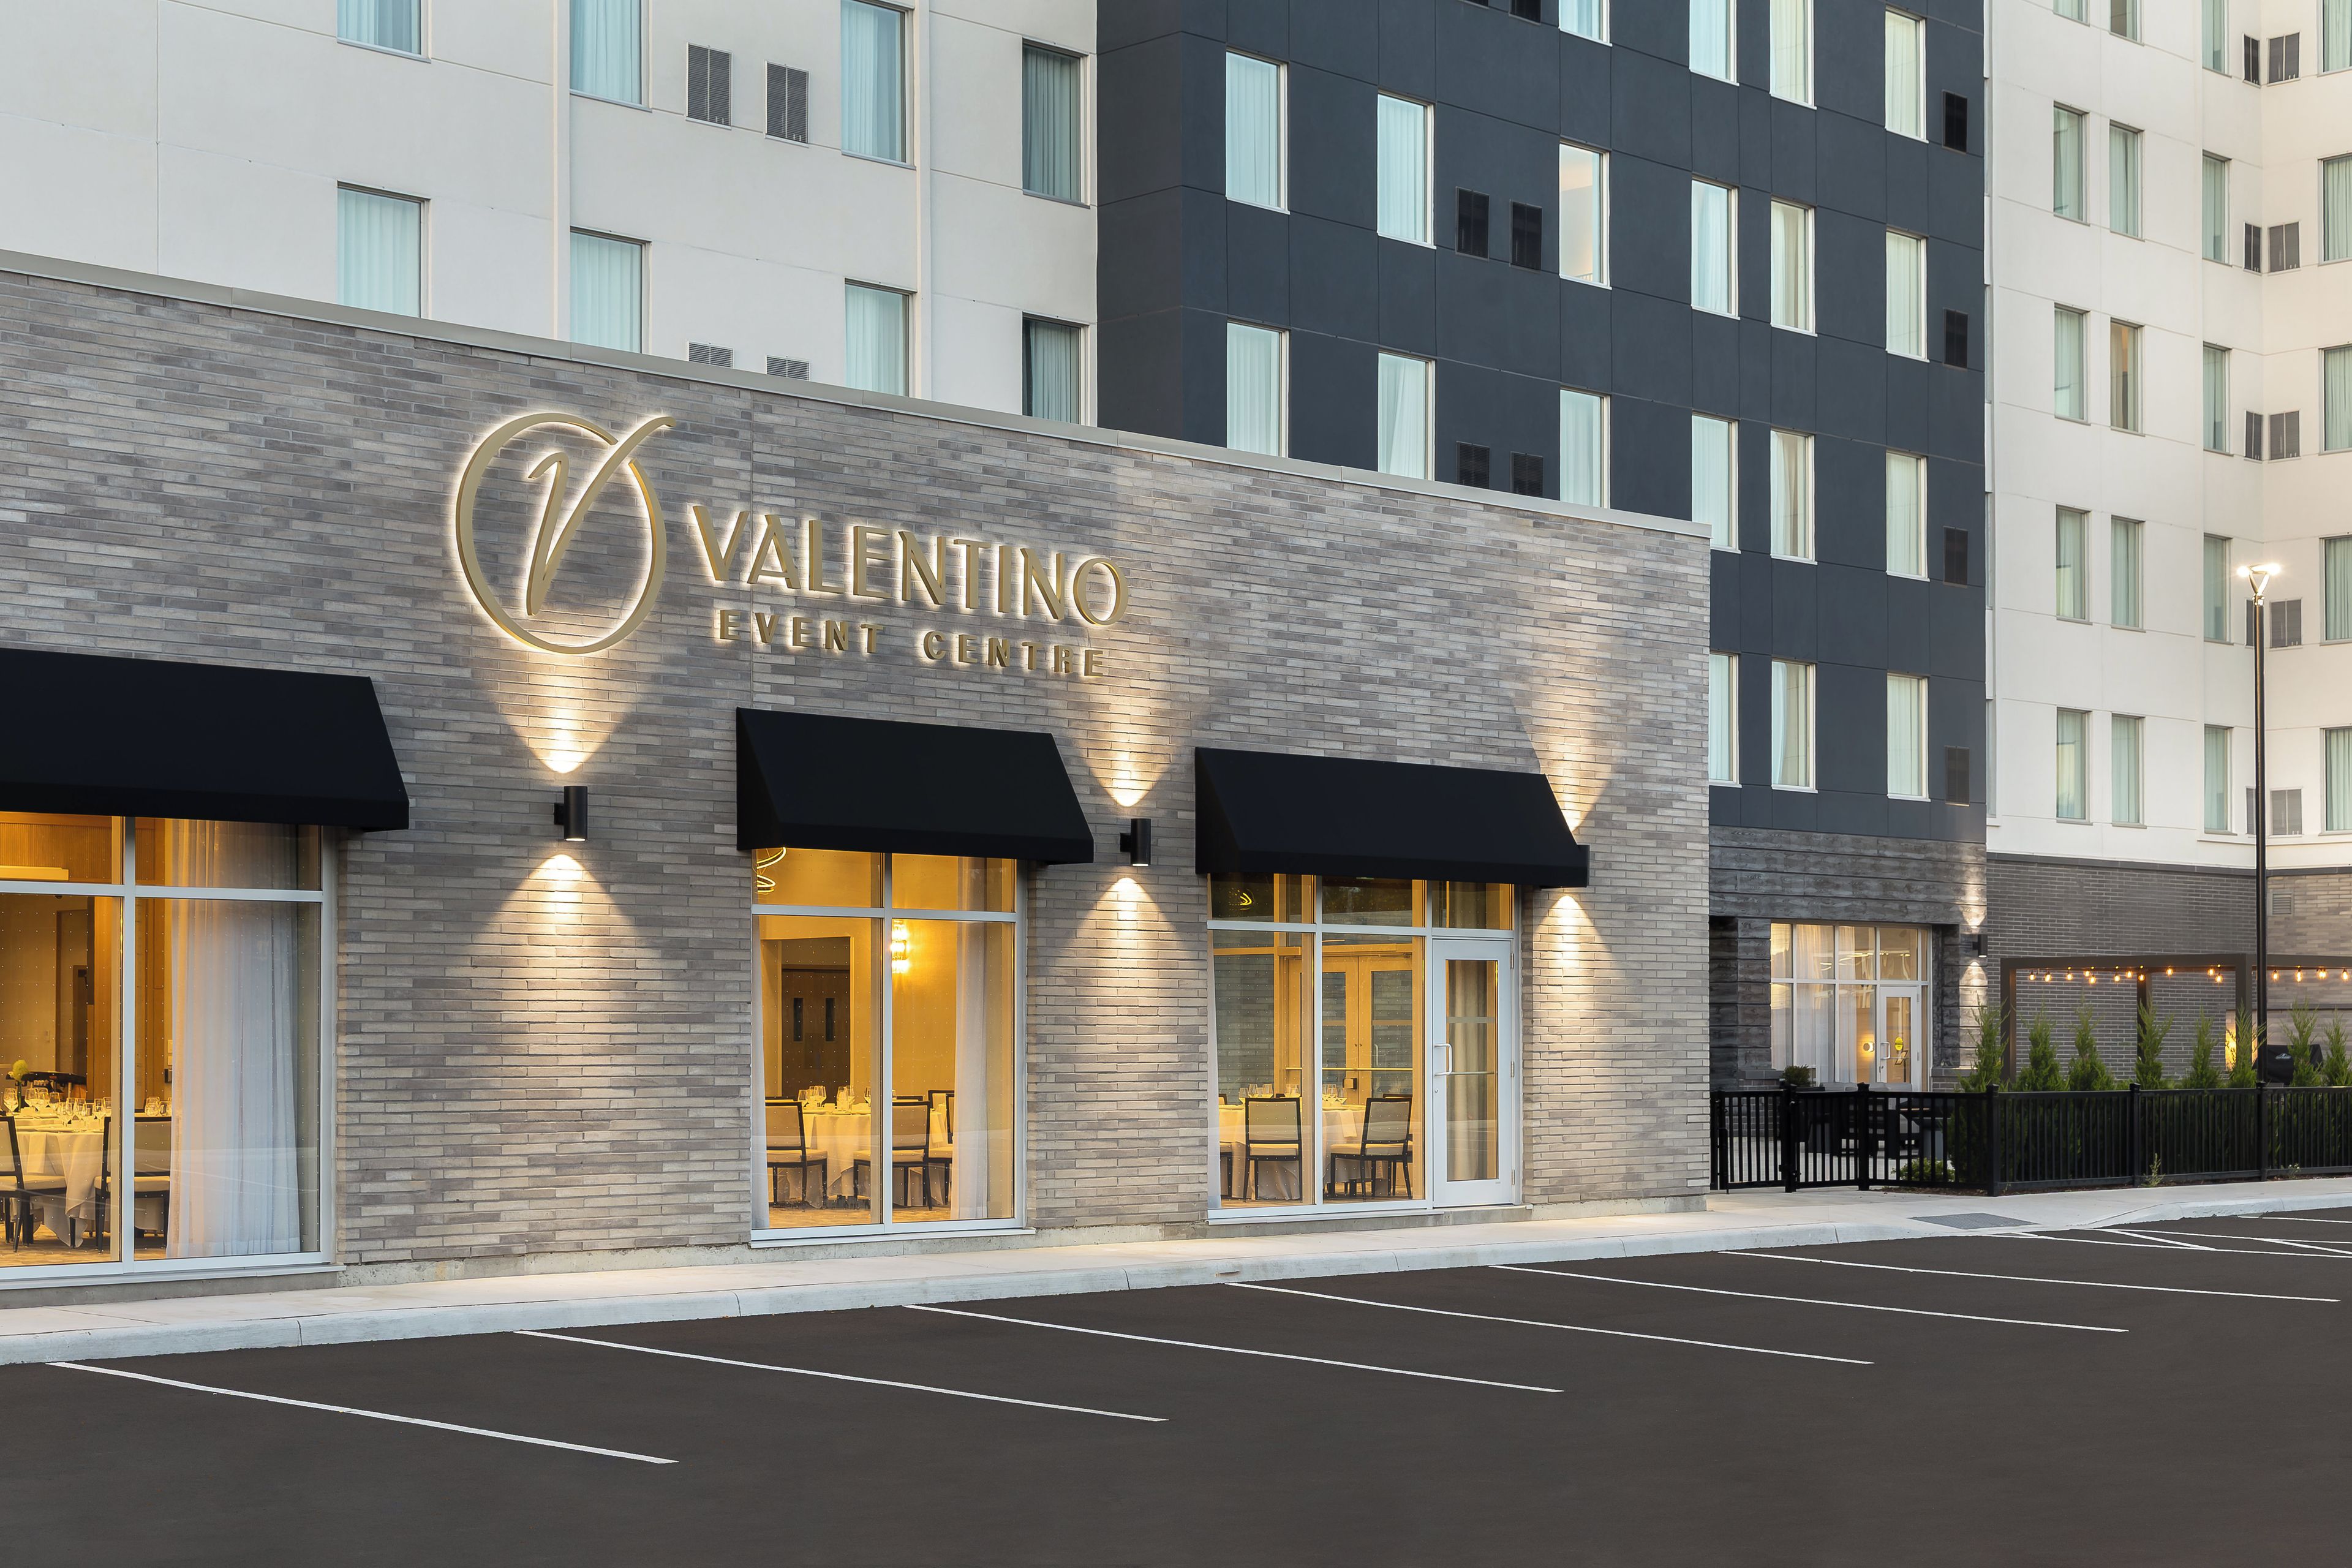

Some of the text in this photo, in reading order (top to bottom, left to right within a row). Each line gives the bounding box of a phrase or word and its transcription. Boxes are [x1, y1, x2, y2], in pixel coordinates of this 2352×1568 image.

[692, 505, 1129, 626] VALENTINO
[719, 609, 1103, 677] EVENT CENTRE
